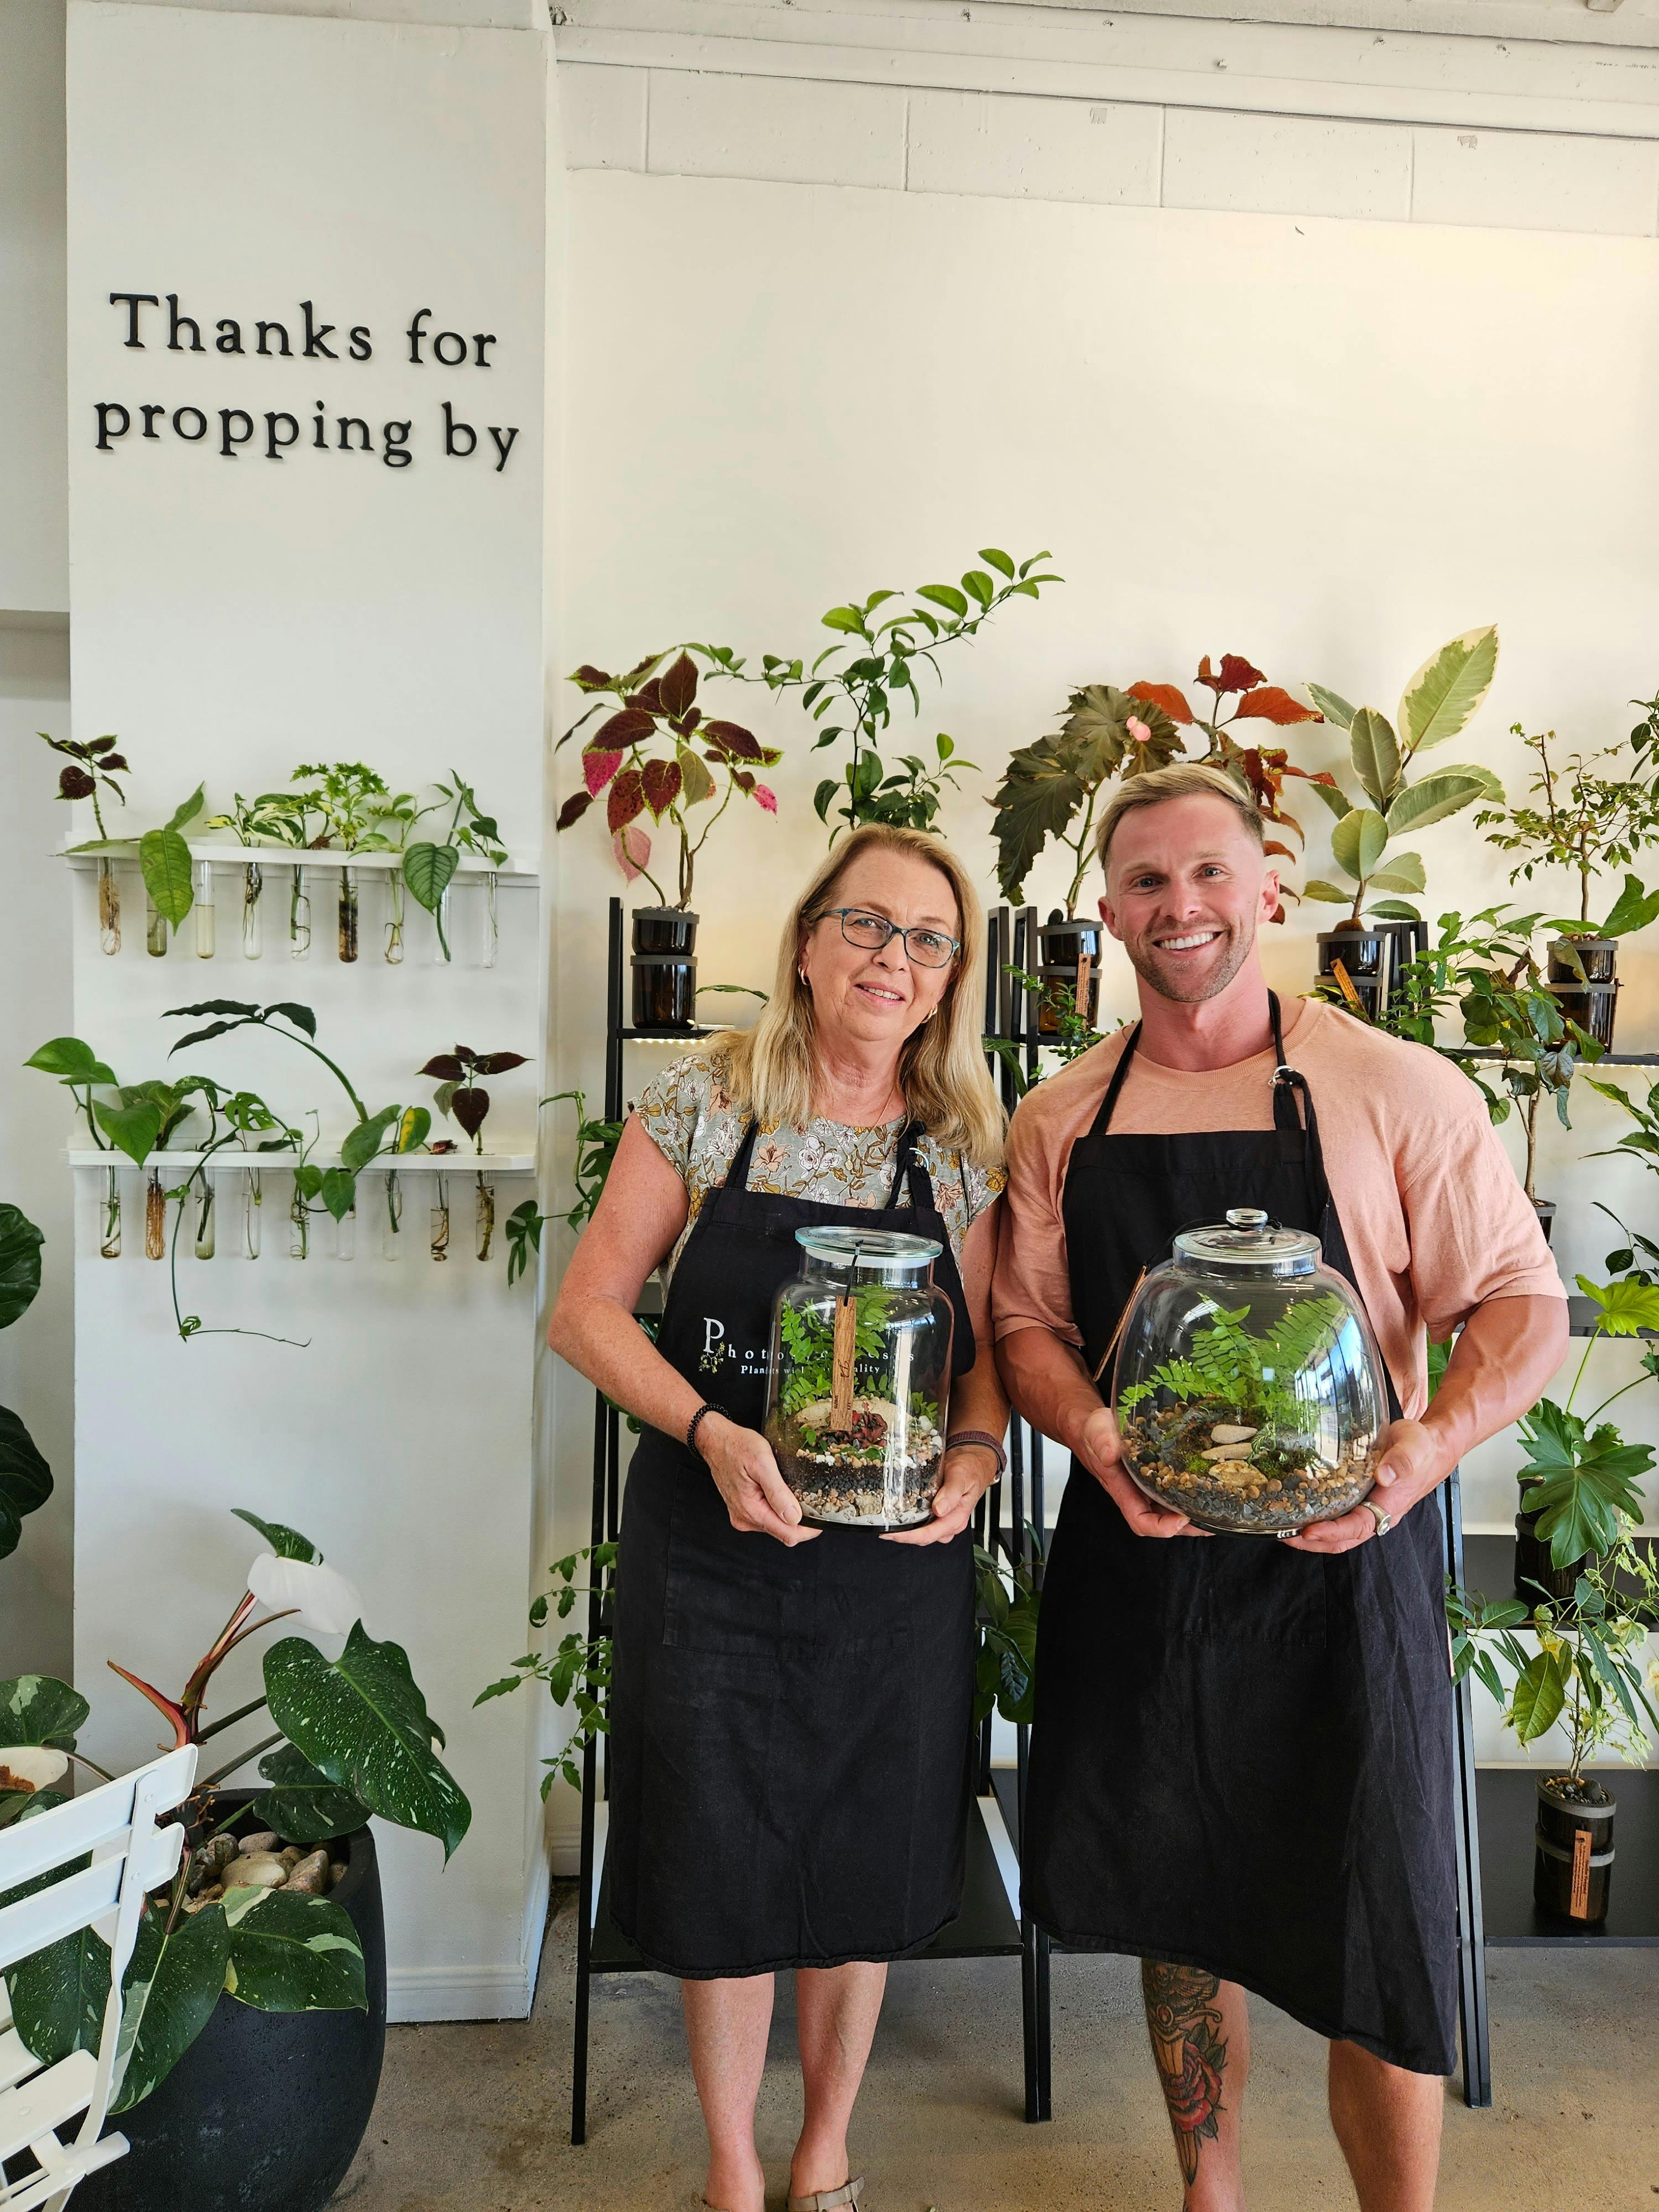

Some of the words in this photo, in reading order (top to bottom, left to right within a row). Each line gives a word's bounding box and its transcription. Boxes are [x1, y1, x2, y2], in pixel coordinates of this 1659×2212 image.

[110, 293, 372, 361] Thanks
[406, 308, 497, 367] for
[93, 400, 413, 468] propping
[441, 401, 519, 472] by
